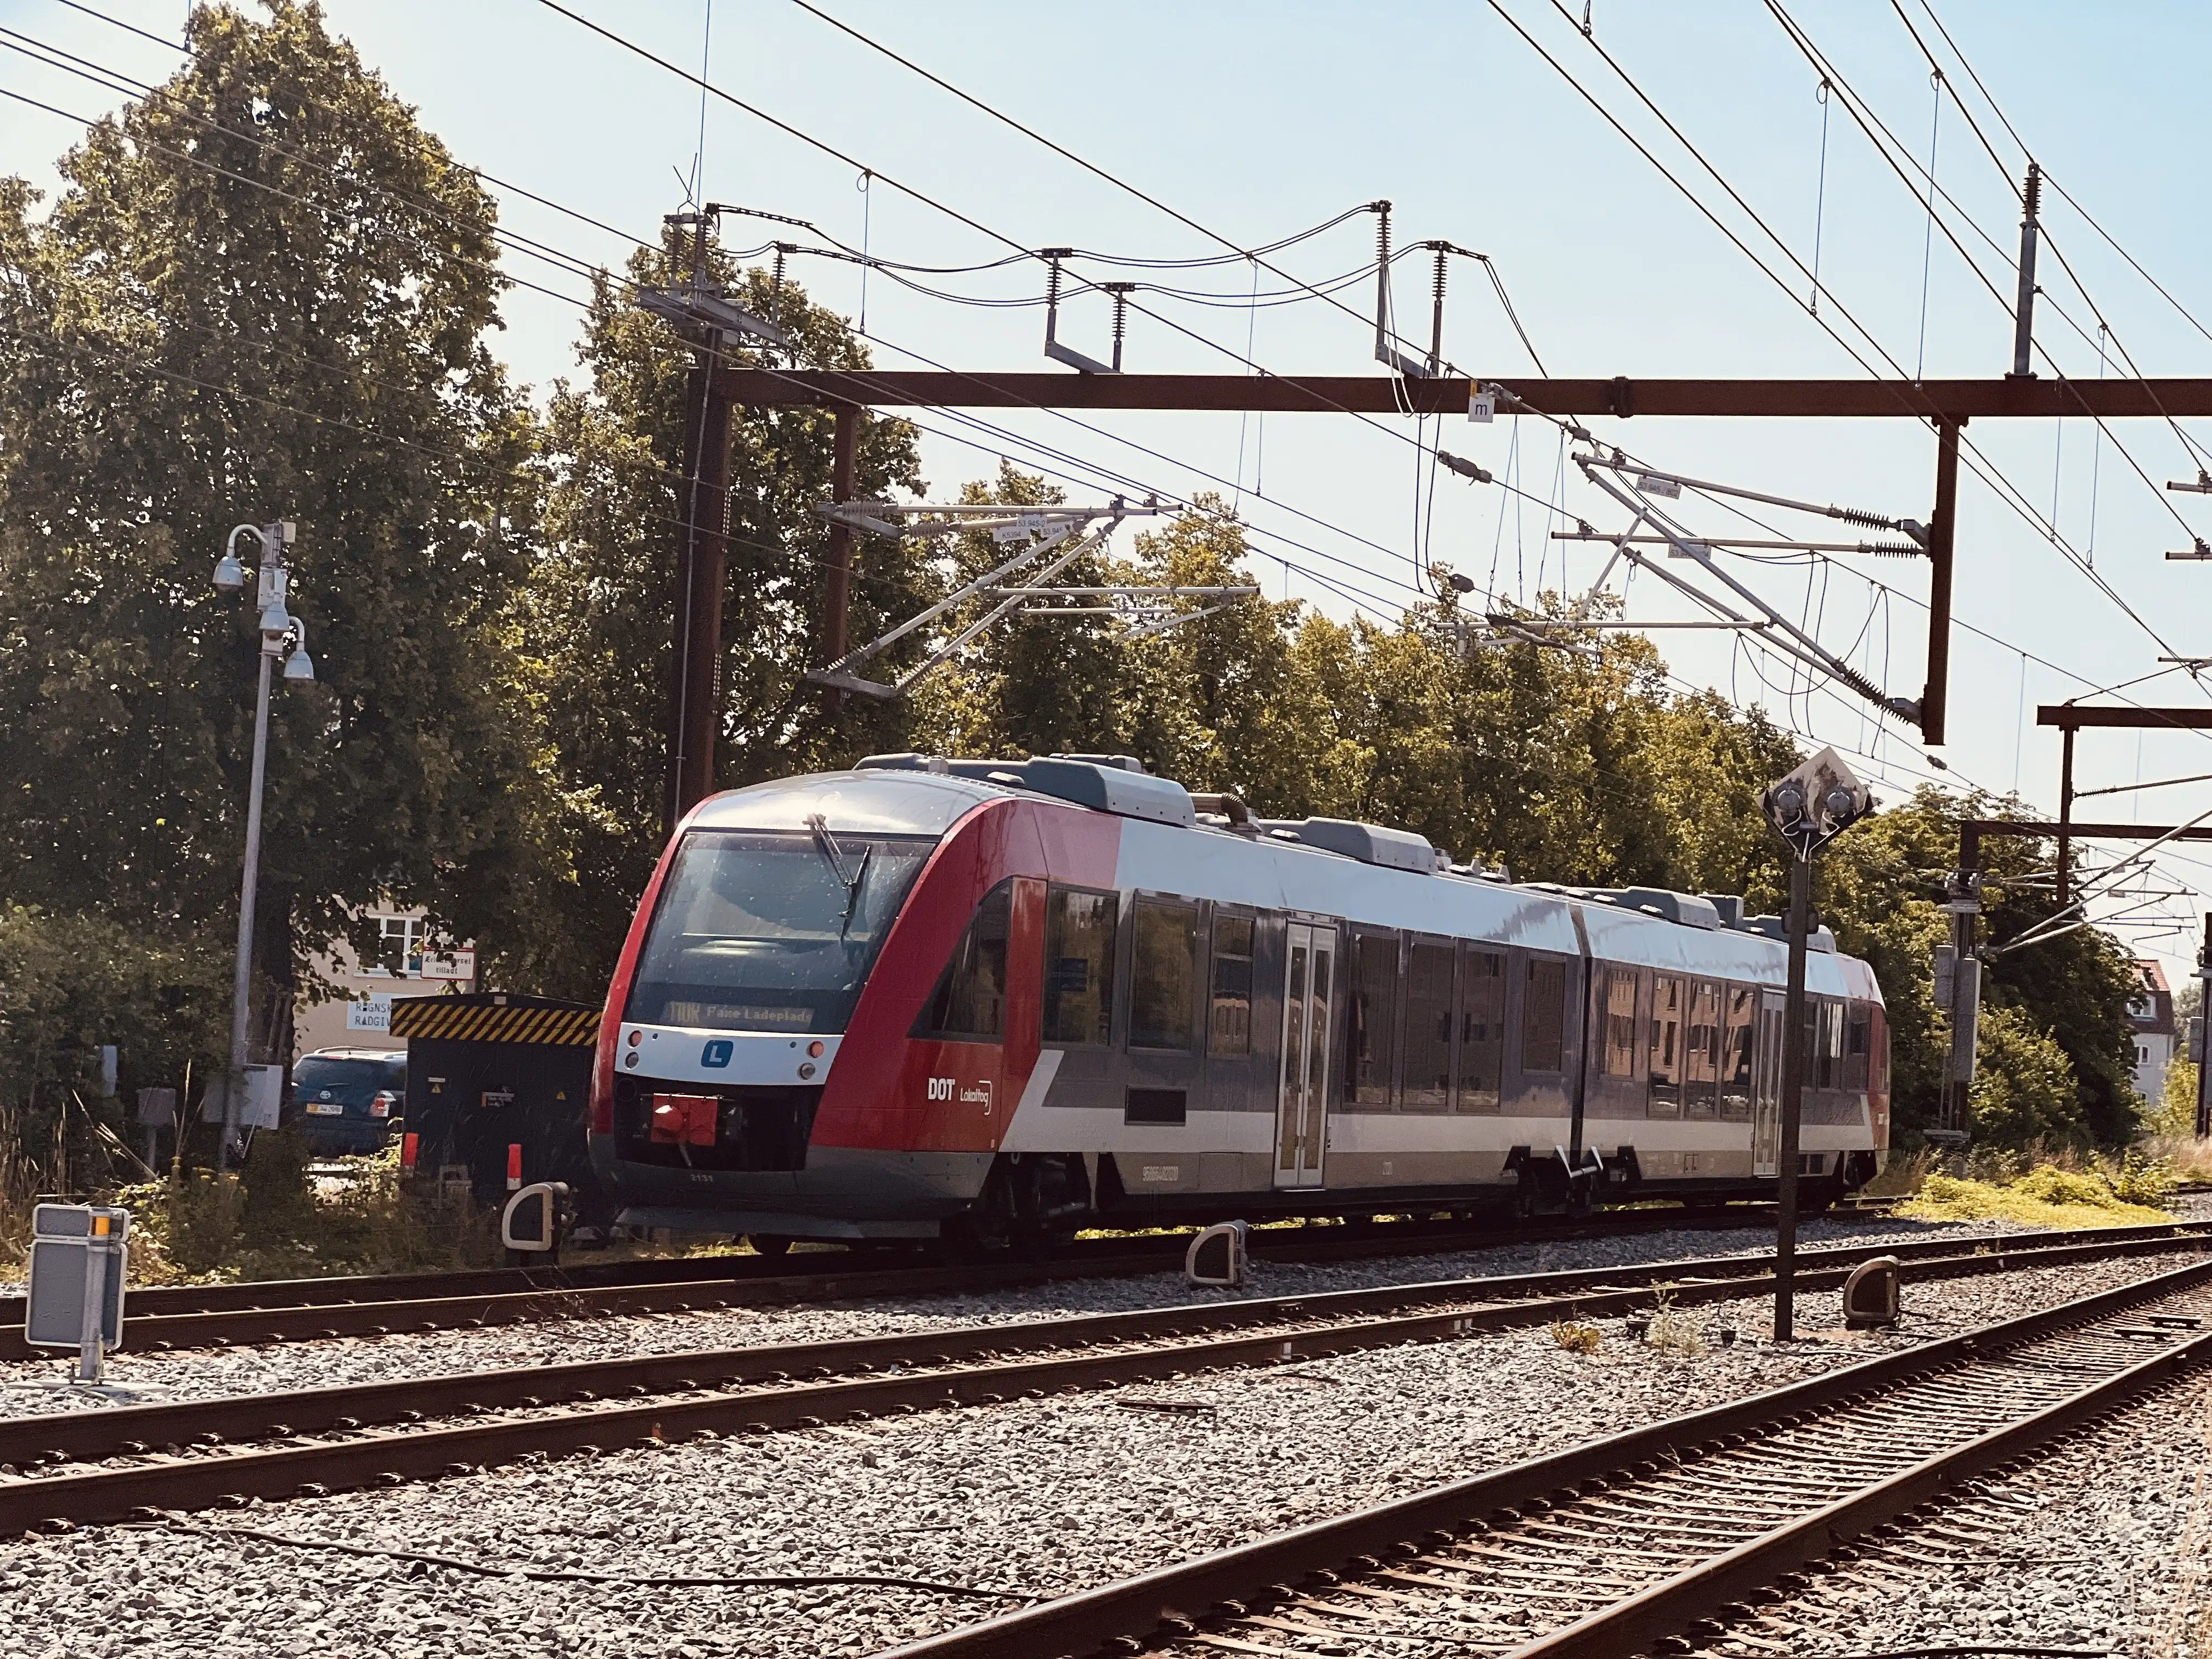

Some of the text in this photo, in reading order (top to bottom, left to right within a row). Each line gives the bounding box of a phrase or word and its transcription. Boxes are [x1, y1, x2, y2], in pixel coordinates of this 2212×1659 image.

[1475, 404, 1487, 415] m
[436, 966, 458, 974] tilladt
[928, 1077, 955, 1101] DOT
